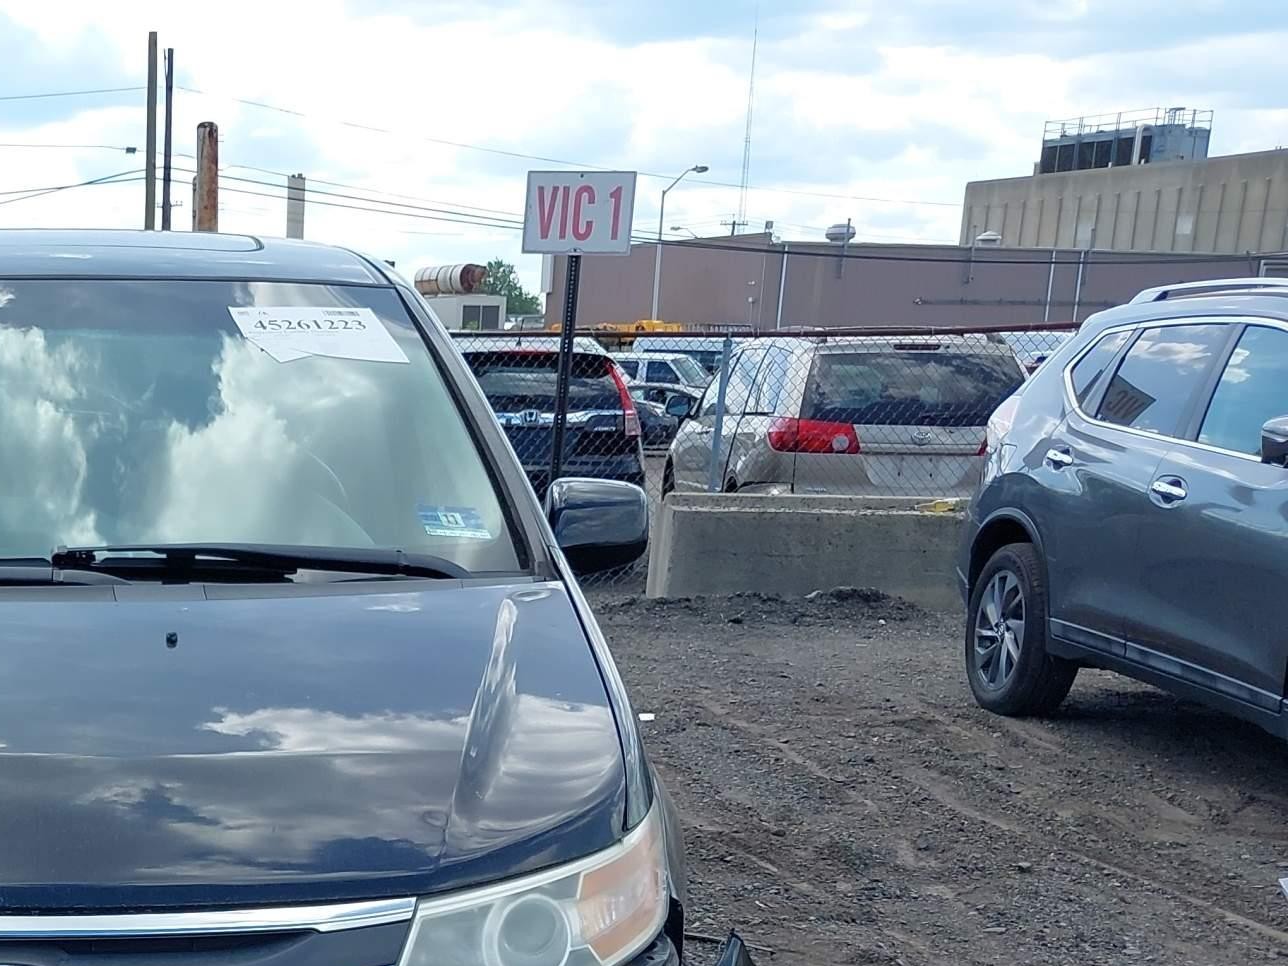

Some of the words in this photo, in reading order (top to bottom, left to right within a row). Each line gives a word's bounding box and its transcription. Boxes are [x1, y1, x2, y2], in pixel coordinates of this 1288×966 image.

[537, 184, 596, 242] VIC
[609, 185, 623, 241] 1
[253, 318, 367, 332] 45261223
